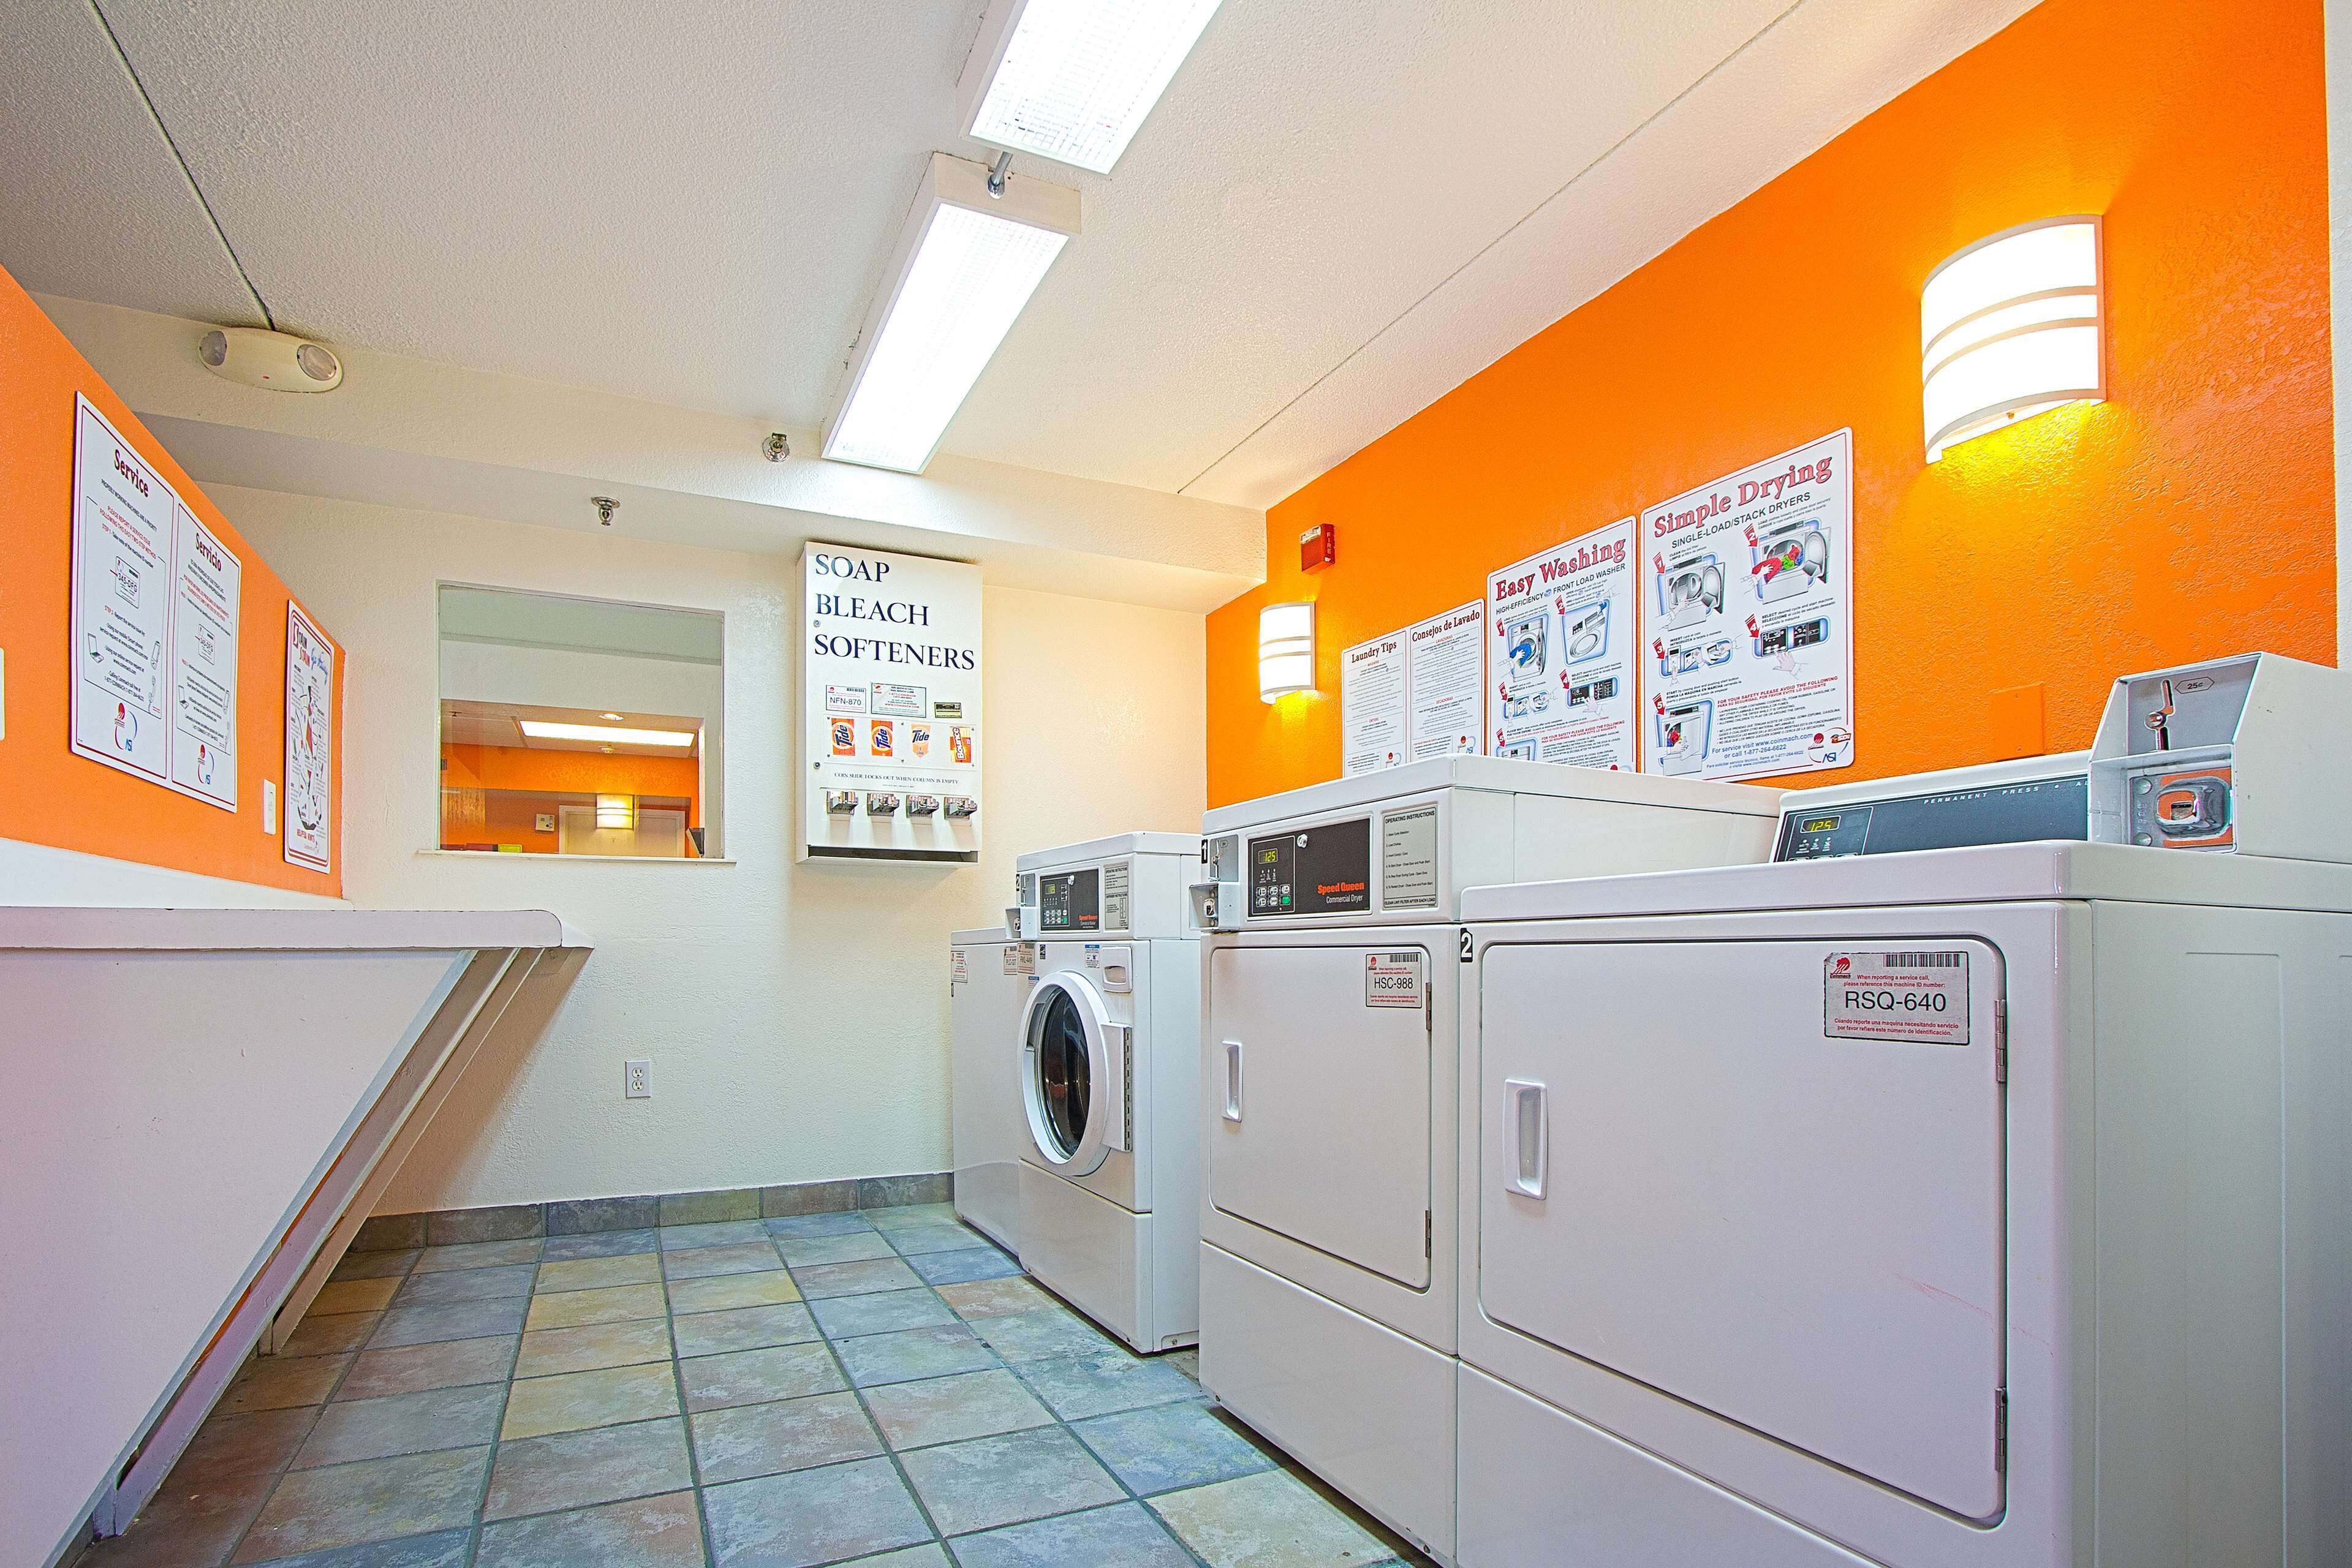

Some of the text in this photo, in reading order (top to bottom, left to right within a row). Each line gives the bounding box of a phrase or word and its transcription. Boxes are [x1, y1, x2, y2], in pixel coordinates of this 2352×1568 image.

[115, 449, 148, 497] Service
[1654, 457, 1832, 537] Simple Drying
[1672, 492, 1810, 548] SINGLE-LOAD/STACK DRYERS
[1749, 533, 1755, 541] 2
[195, 532, 221, 571] Servicio
[815, 554, 890, 582] SOAP
[1496, 573, 1535, 601] Easy
[1540, 539, 1625, 582] Washing
[1496, 564, 1625, 615] HIGH-EFFICIENCY FRONT LOAD WASHER
[815, 594, 929, 626] BLEACH
[1412, 610, 1480, 642] Consejos de Lavado
[814, 634, 974, 670] SOFTENERS
[1352, 642, 1397, 663] Laundry Tips
[1807, 676, 1838, 686] FOLLOWING
[830, 697, 861, 706] NFN-870
[835, 725, 852, 747] Tide
[875, 728, 891, 748] Tide
[912, 729, 929, 743] Tide
[953, 728, 964, 760] Bounce
[1722, 744, 1741, 753] service
[1742, 741, 1754, 750] visit
[1755, 733, 1813, 748] www.coinmach.com
[1924, 792, 1987, 804] PERMANENT
[2002, 786, 2040, 796] PRESS
[1385, 810, 1435, 824] OPERATING INSTRUCTIONS
[1202, 842, 1208, 860] 1
[1265, 851, 1276, 862] 125
[1318, 882, 1364, 895] Speed Queen
[1326, 894, 1363, 903] Commercial Dryer
[1461, 932, 1472, 958] 2
[1374, 977, 1413, 989] HSC-988
[1845, 991, 1946, 1012] RSQ-640
